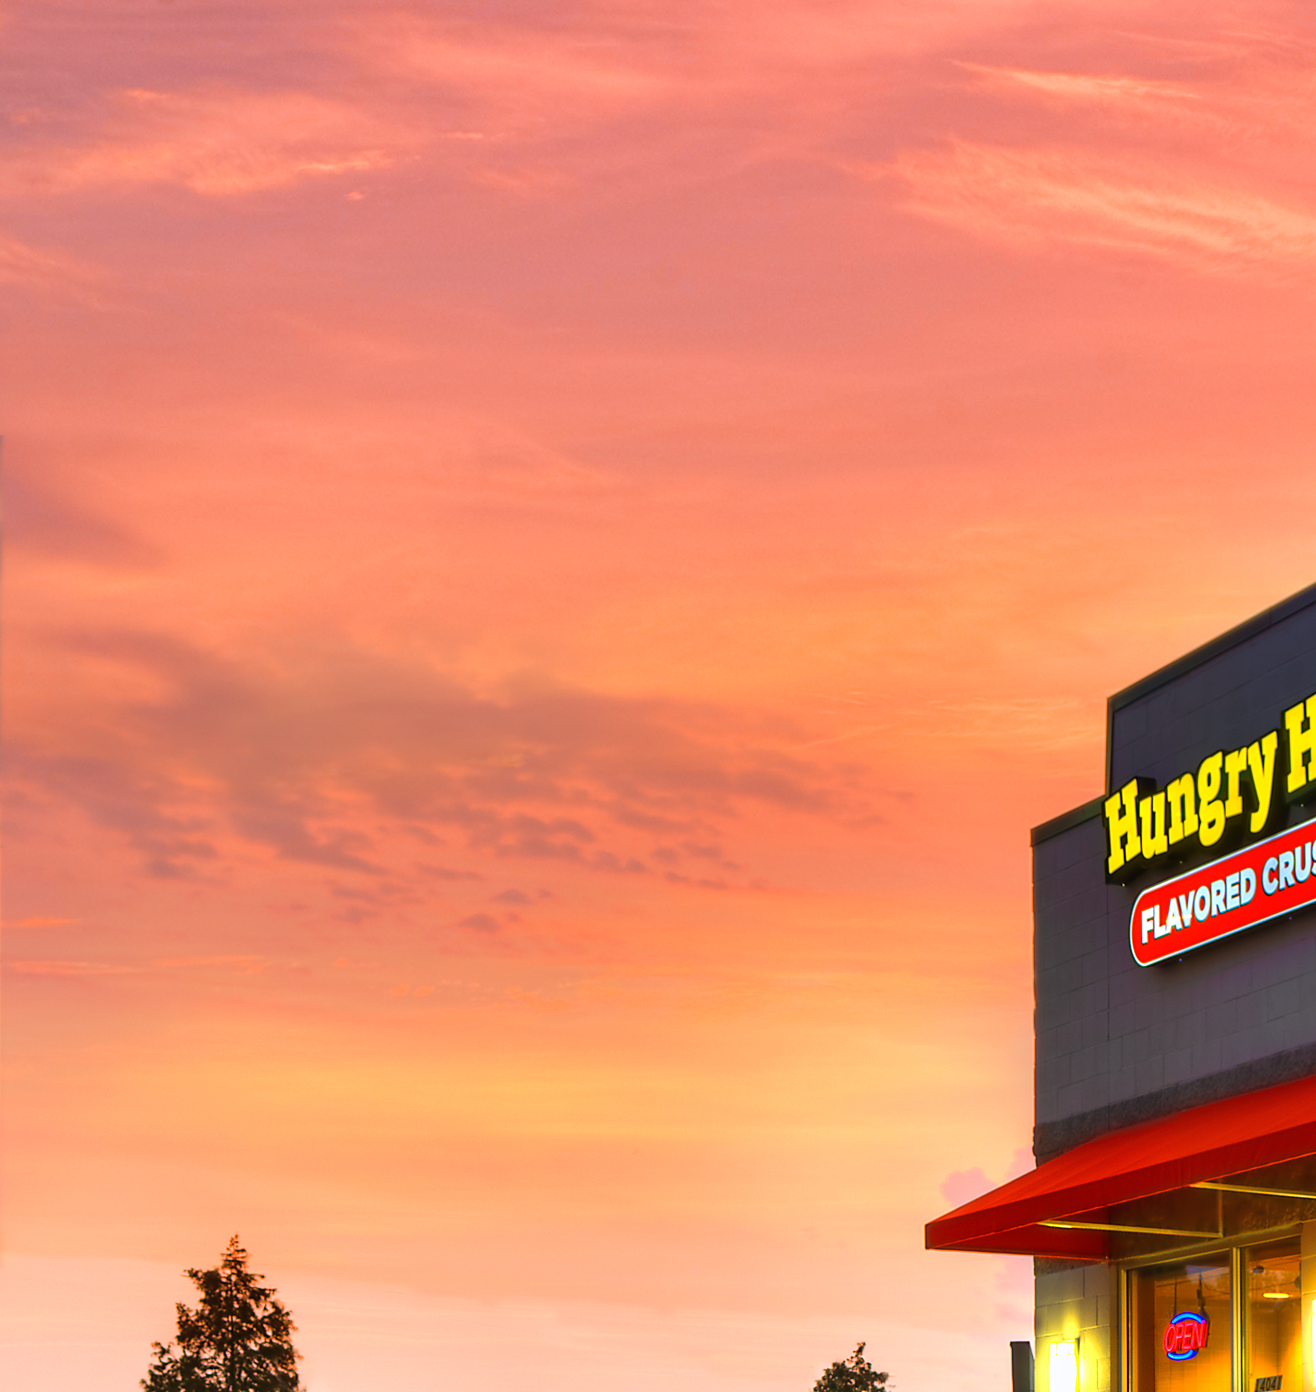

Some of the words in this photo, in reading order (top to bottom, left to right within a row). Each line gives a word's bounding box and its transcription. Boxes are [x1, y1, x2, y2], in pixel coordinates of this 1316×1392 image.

[1104, 731, 1278, 874] Hungry
[1141, 867, 1257, 944] FLAVORED
[1164, 1320, 1208, 1352] OPEN
